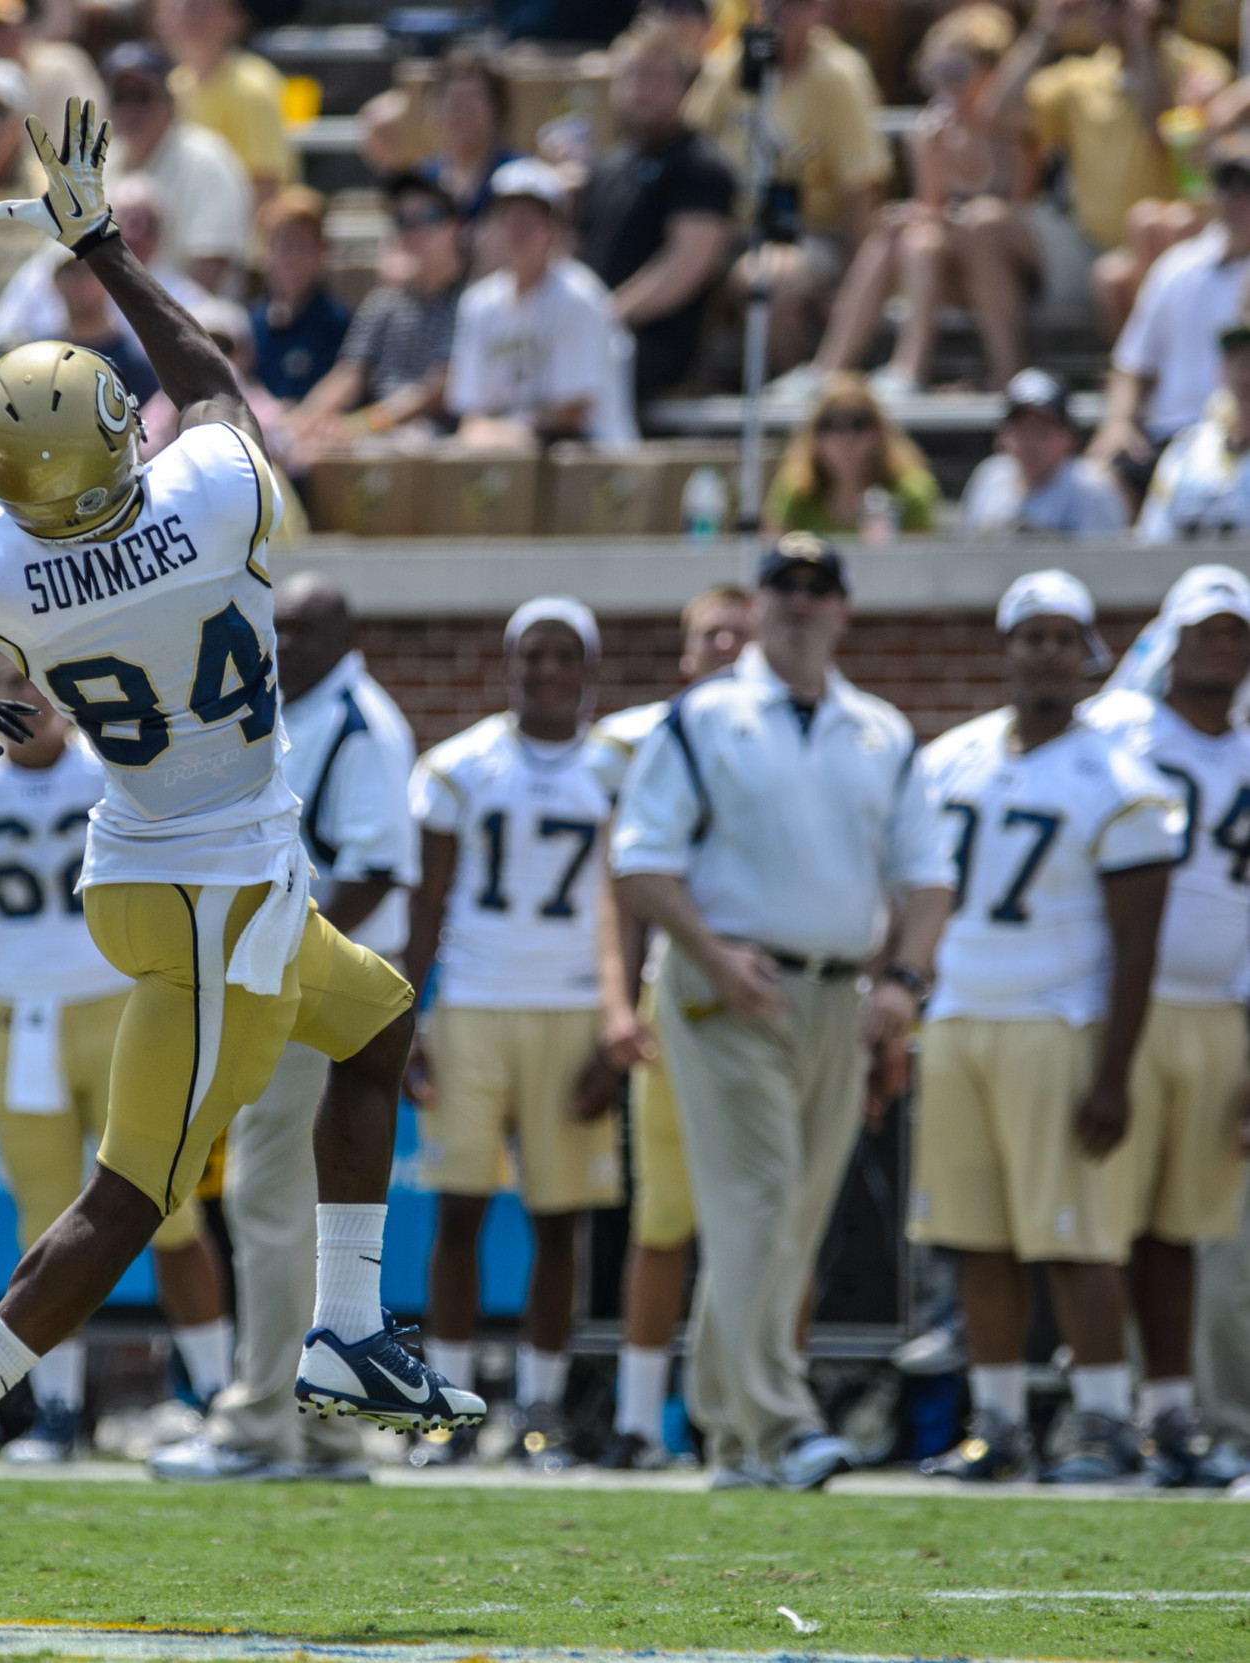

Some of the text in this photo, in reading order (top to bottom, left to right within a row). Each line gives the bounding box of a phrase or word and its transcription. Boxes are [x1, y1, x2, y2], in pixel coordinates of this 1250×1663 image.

[23, 513, 198, 615] SUMMERS
[43, 594, 277, 770] 84
[480, 811, 597, 918] 17
